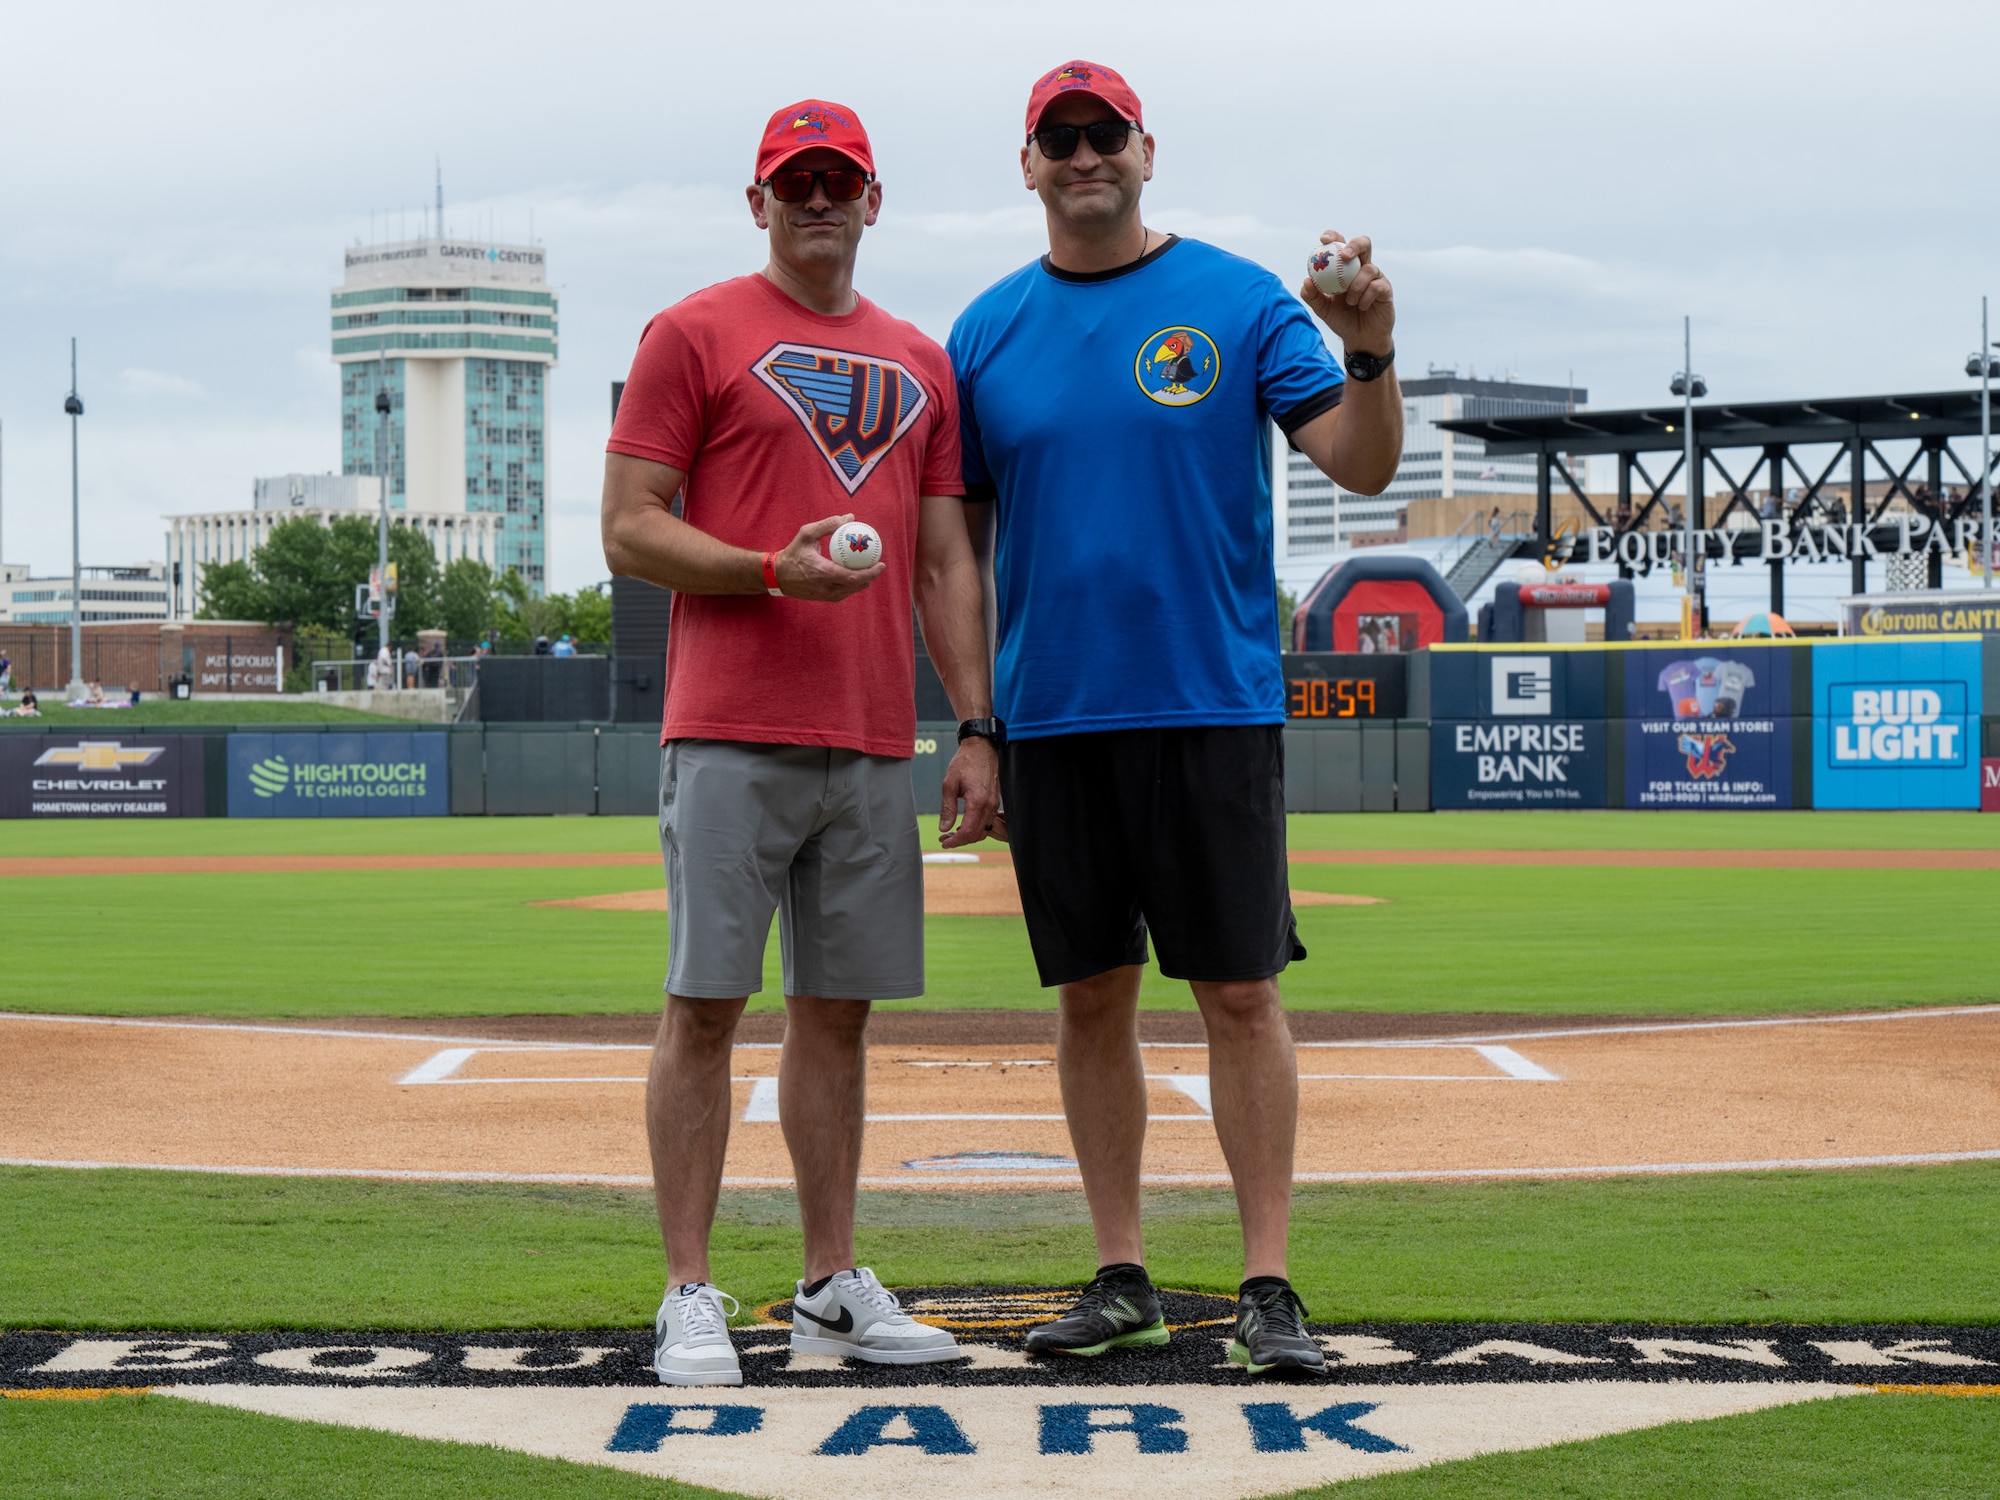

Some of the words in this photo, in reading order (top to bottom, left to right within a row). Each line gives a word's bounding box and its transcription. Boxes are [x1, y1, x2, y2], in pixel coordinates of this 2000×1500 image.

[440, 245, 487, 260] GARVEY
[498, 249, 544, 265] CENTER
[1588, 526, 1743, 572] EQUITY
[1761, 519, 1879, 562] BANK
[1861, 607, 1938, 635] Corona
[1291, 680, 1375, 717] 30:59
[1853, 689, 1941, 725] BUD
[1641, 722, 1670, 733] VISIT
[1672, 722, 1697, 733] OUR
[1700, 722, 1731, 733] TEAM
[1733, 722, 1774, 733] STORE!
[1456, 725, 1585, 752] EMPRISE
[1836, 725, 1959, 761] LIGHT
[294, 763, 426, 782] HIGHTOUCH
[32, 779, 167, 791] CHEVROLET
[294, 784, 426, 798] TECHNOLOGIES
[1649, 782, 1672, 793] FOR
[1675, 782, 1720, 793] TICKETS
[1467, 789, 1524, 801] Empowering
[1525, 789, 1543, 800] You
[1543, 790, 1554, 800] to
[1708, 793, 1777, 805] windsurge.com
[32, 801, 90, 813] HOMETOWN
[91, 801, 123, 813] CHEVY
[123, 801, 167, 813] DEALERS
[605, 1400, 1411, 1456] PARK
